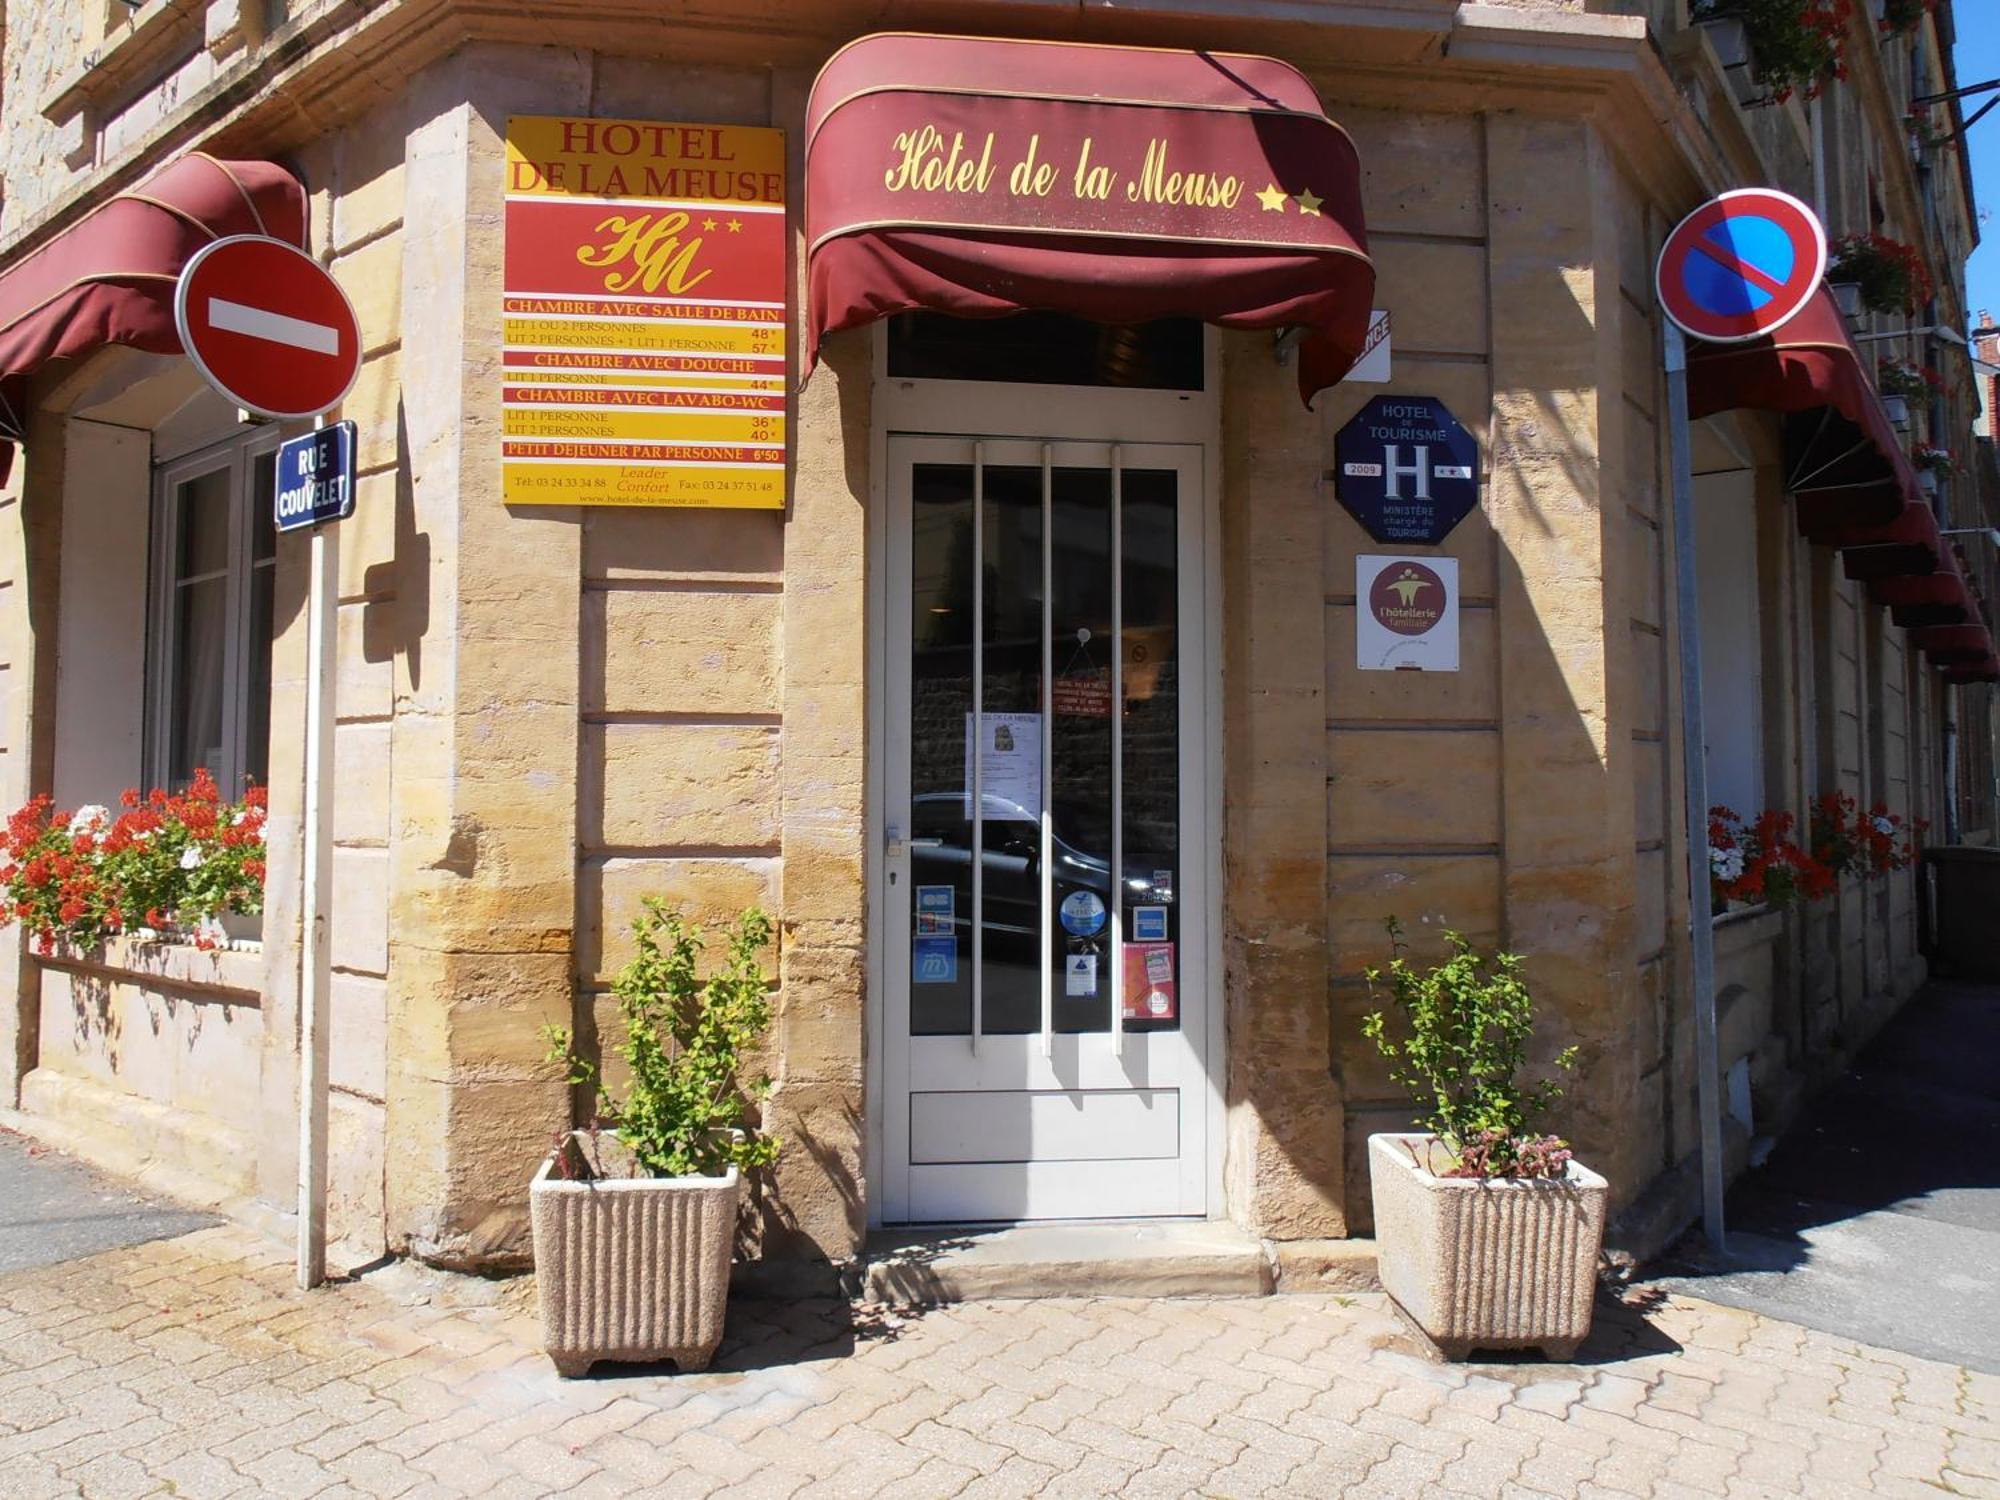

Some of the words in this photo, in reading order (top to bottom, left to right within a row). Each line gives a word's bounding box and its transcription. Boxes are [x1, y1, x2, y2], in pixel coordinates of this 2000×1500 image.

[560, 121, 735, 162] HOTEL
[885, 124, 996, 193] Hôtel
[1009, 134, 1060, 197] de
[1073, 137, 1118, 200] la
[1127, 138, 1245, 209] Meuse
[512, 160, 566, 192] DE
[578, 163, 630, 196] LA
[642, 166, 782, 203] MEUSE
[506, 299, 596, 314] CHAMBRE
[601, 302, 649, 316] AVEC
[652, 304, 704, 318] SALLE
[709, 307, 733, 319] DE
[737, 309, 779, 321] BAIN
[507, 319, 526, 329] LIT
[530, 320, 537, 329] 1
[540, 320, 558, 330] OU
[562, 321, 569, 330] 2
[572, 321, 647, 333] PERSONNES
[507, 334, 526, 343] LIT
[530, 335, 537, 344] 2
[540, 335, 614, 346] PERSONNES
[635, 338, 655, 348] LIT
[659, 339, 666, 348] 1
[669, 339, 737, 351] PERSONNE
[534, 353, 624, 367] CHAMBRE
[628, 356, 677, 370] AVEC
[680, 359, 755, 373] DOUCHE
[507, 372, 526, 382] LIT
[530, 373, 536, 382] 1
[539, 373, 608, 384] PERSONNE
[516, 388, 605, 403] CHAMBRE
[611, 391, 659, 405] AVEC
[663, 393, 769, 409] LAVABO-WC
[507, 410, 527, 420] LIT
[530, 411, 536, 420] 1
[540, 411, 609, 422] PERSONNE
[1382, 405, 1432, 419] HOTEL
[507, 424, 527, 434] LIT
[530, 425, 537, 435] 2
[540, 425, 615, 437] PERSONNES
[1368, 426, 1447, 442] TOURISME
[508, 442, 551, 455] PETIT
[554, 444, 628, 458] DEJEUNER
[632, 446, 661, 459] PAR
[666, 447, 744, 460] PERSONNE
[298, 443, 328, 476] RUE
[620, 466, 668, 479] Leader
[1350, 464, 1376, 475] 2009
[1382, 444, 1434, 501] H
[536, 478, 549, 487] 03
[551, 478, 562, 488] 24
[565, 478, 577, 488] 33
[580, 478, 591, 488] 34
[594, 478, 606, 488] 88
[616, 480, 670, 493] Confort
[703, 480, 714, 490] 03
[716, 480, 728, 490] 24
[762, 482, 772, 491] 48
[279, 474, 345, 518] COUVELET
[1386, 527, 1431, 538] TOURISME
